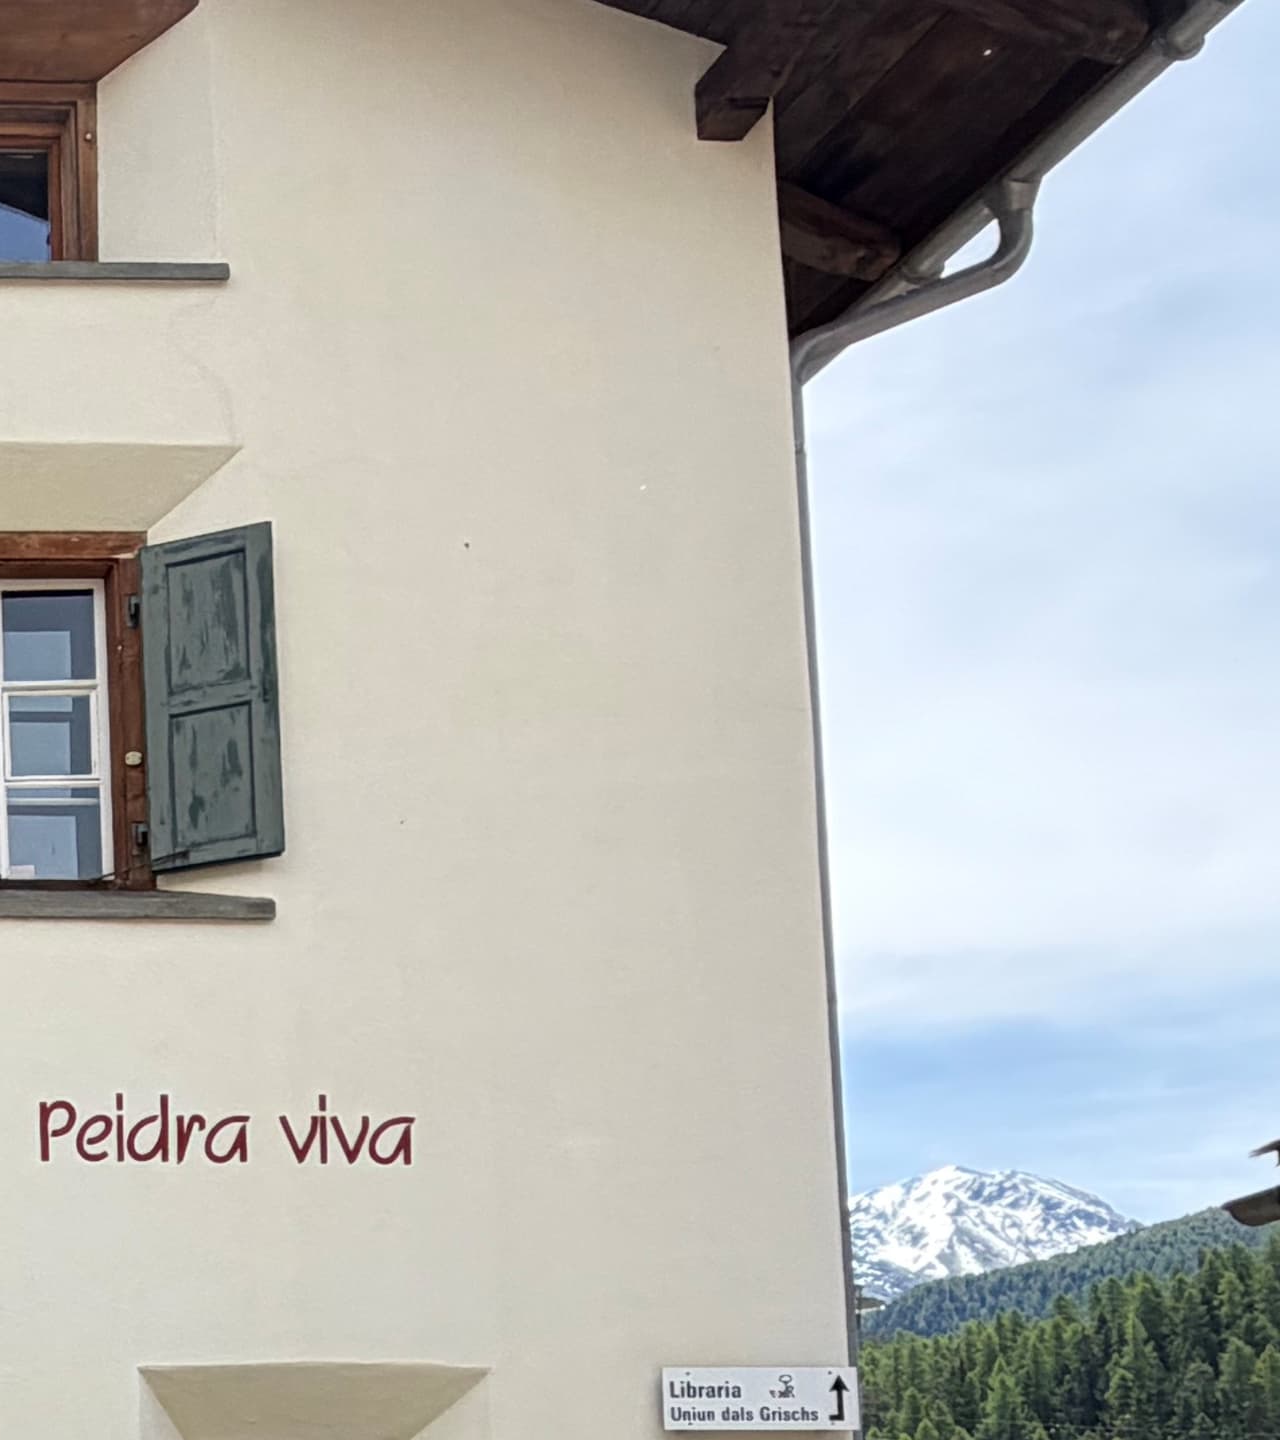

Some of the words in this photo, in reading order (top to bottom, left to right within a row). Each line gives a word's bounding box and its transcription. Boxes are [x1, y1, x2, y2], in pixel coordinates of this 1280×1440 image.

[39, 1093, 251, 1165] Peidra
[279, 1094, 416, 1166] viva
[669, 1380, 742, 1399] Libraria
[670, 1406, 715, 1422] Uniun
[721, 1406, 754, 1422] dals
[759, 1406, 819, 1422] Grischs
